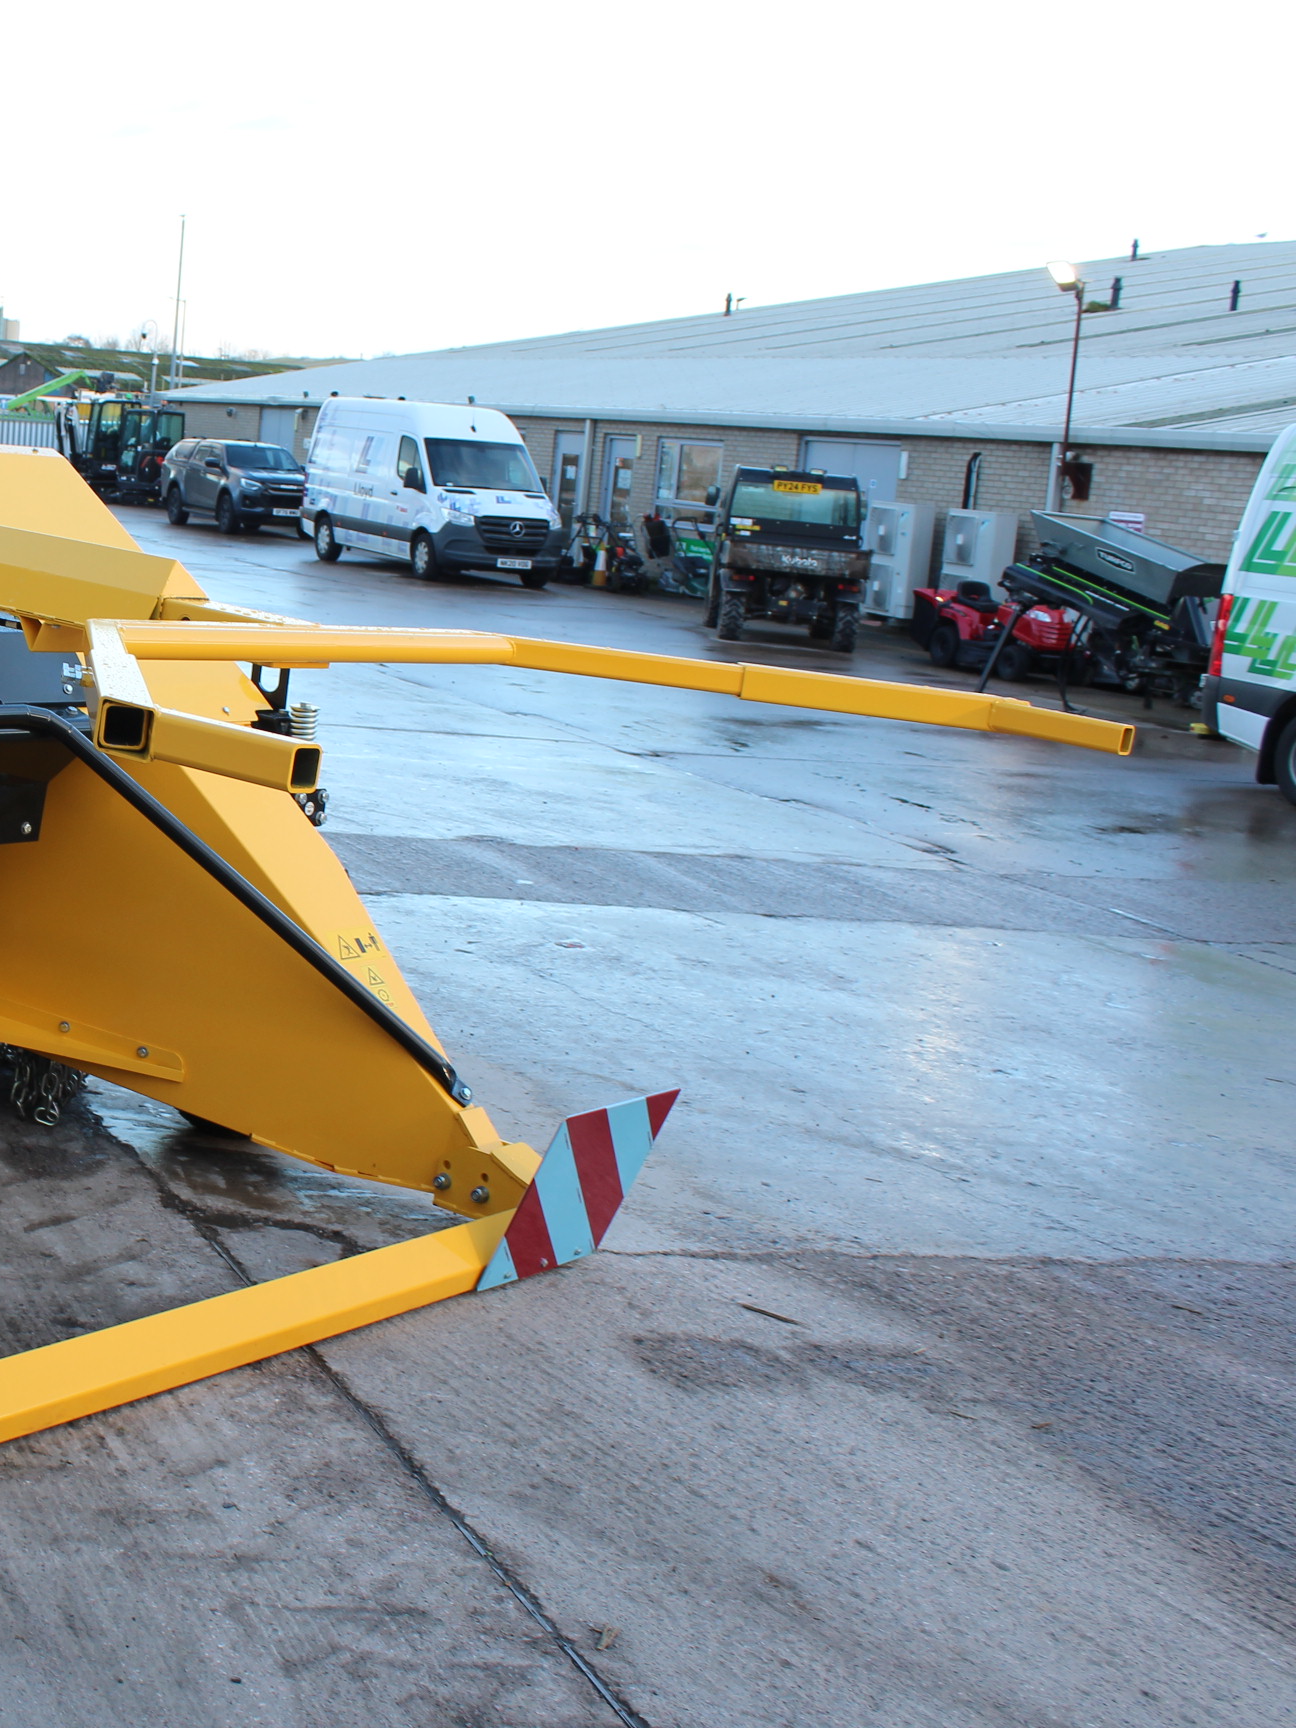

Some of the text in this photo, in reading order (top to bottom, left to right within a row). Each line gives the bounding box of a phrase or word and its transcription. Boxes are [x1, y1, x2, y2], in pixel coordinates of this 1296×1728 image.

[776, 481, 819, 493] PY24 FYS
[781, 554, 818, 568] Kubota
